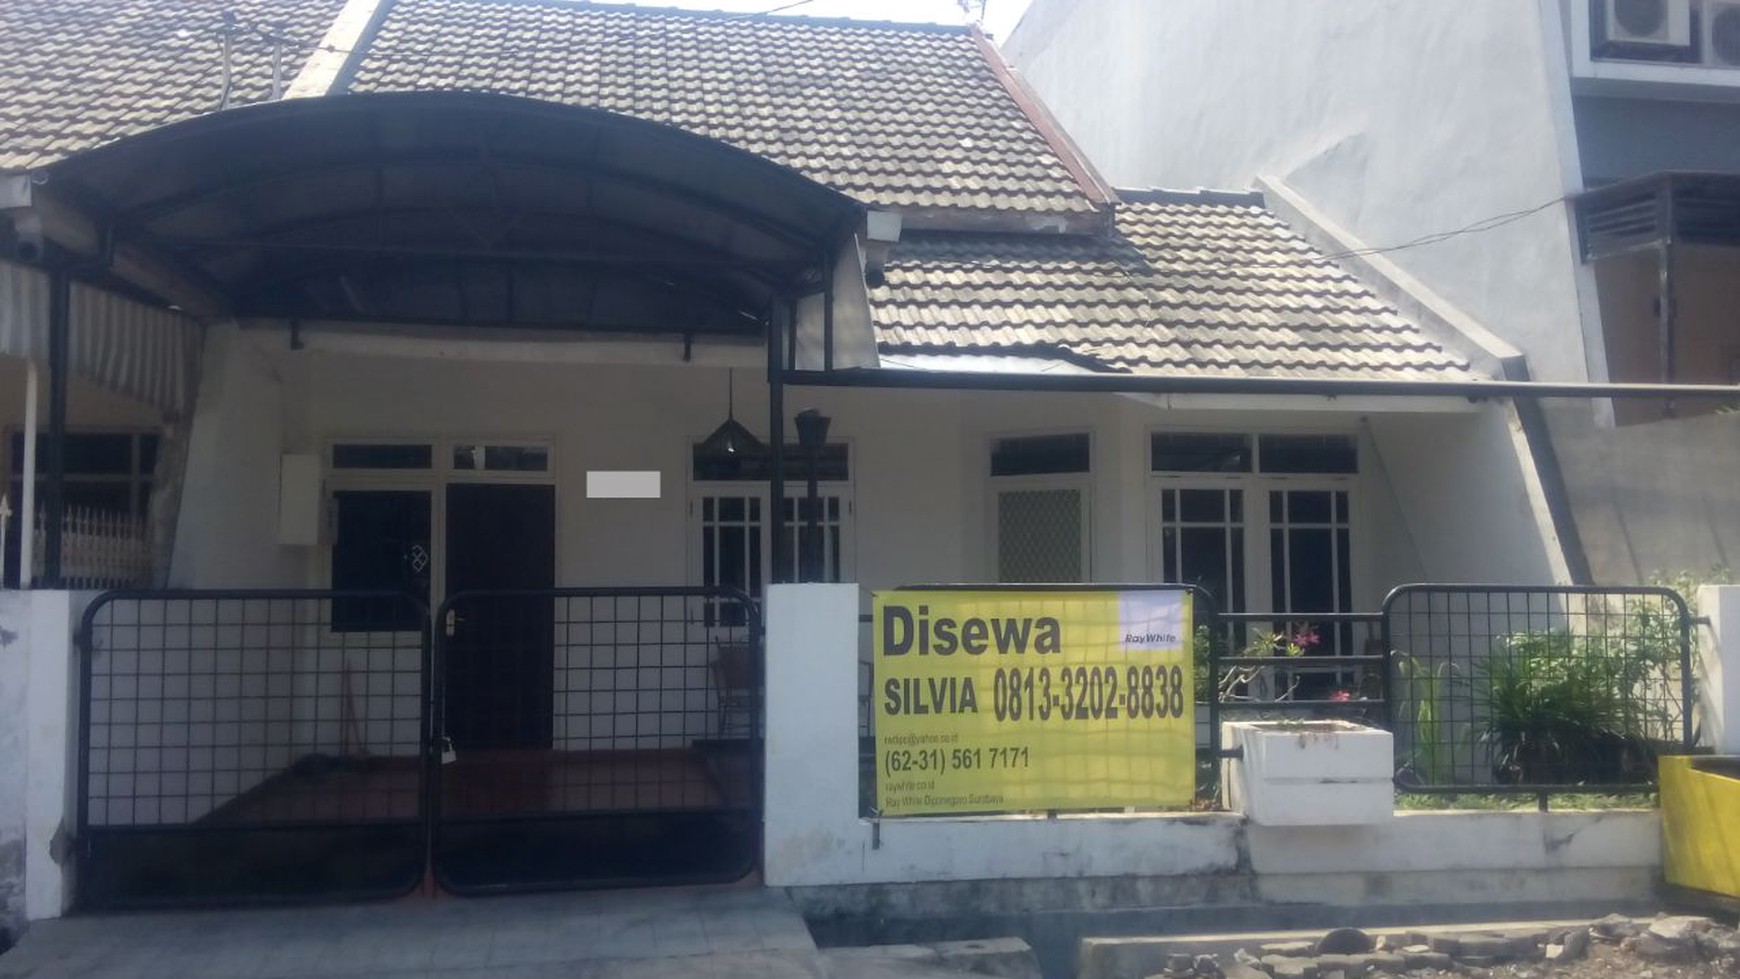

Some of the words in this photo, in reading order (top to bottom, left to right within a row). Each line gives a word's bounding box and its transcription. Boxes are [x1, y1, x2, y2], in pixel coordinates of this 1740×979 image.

[883, 605, 1061, 656] Disewa
[884, 677, 978, 715] SILVIA
[993, 665, 1184, 722] 0813-3202-8838
[885, 748, 946, 778] (62-31)
[952, 748, 981, 769] 561
[989, 746, 1029, 768] 7171
